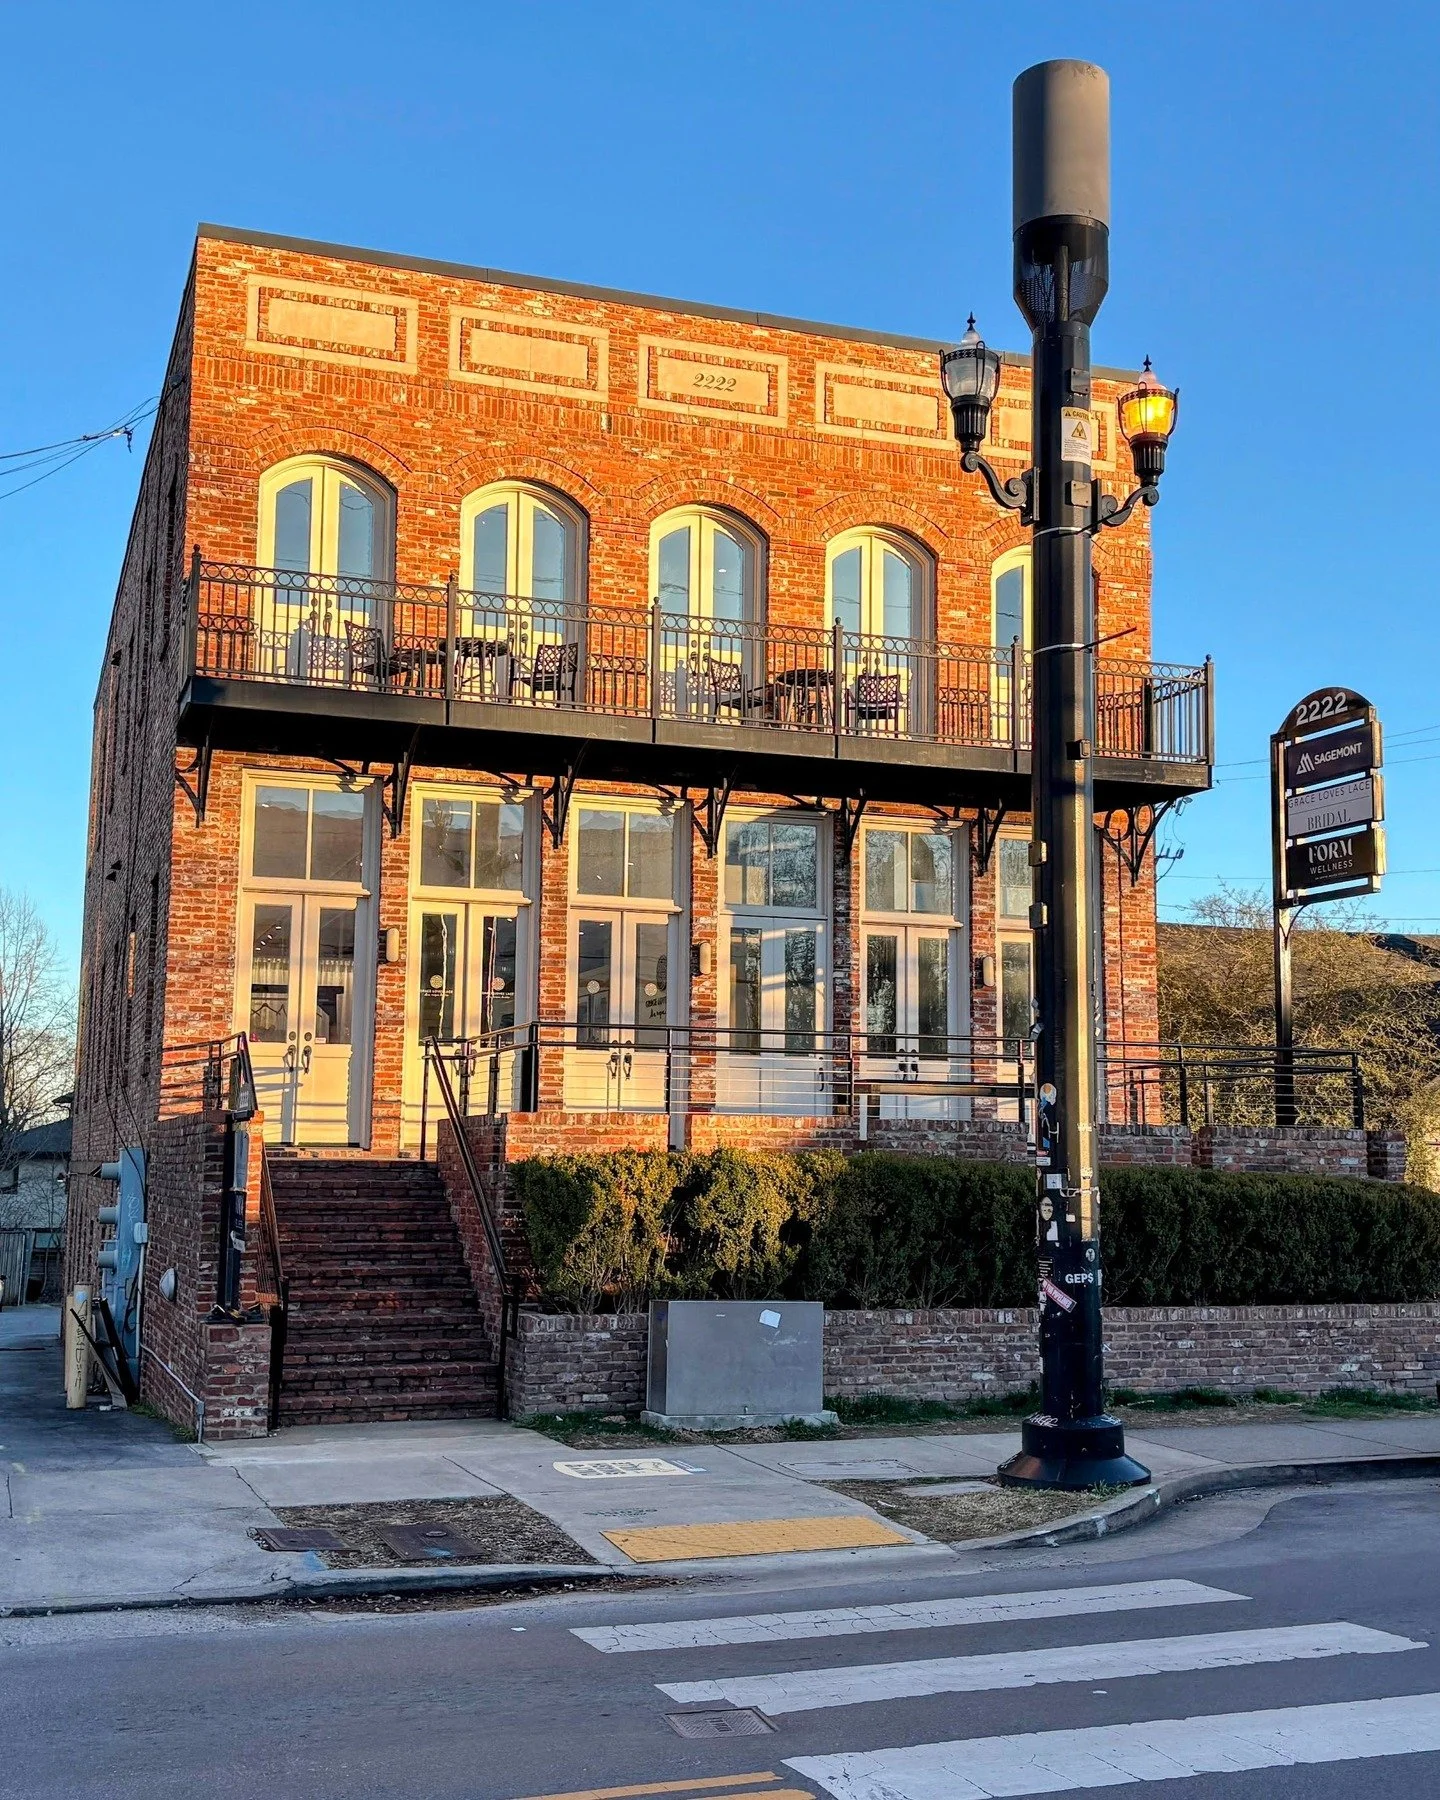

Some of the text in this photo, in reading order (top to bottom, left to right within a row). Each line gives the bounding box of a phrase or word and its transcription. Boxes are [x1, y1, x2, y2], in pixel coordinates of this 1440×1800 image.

[693, 373, 737, 392] 2222
[1296, 692, 1348, 726] 2222
[1314, 742, 1362, 765] SAGEMONT
[1288, 780, 1370, 808] GRACE LOVES LACE
[1307, 809, 1351, 830] BRIDAL
[1308, 838, 1353, 863] FORM
[1309, 859, 1353, 875] WELLNESS
